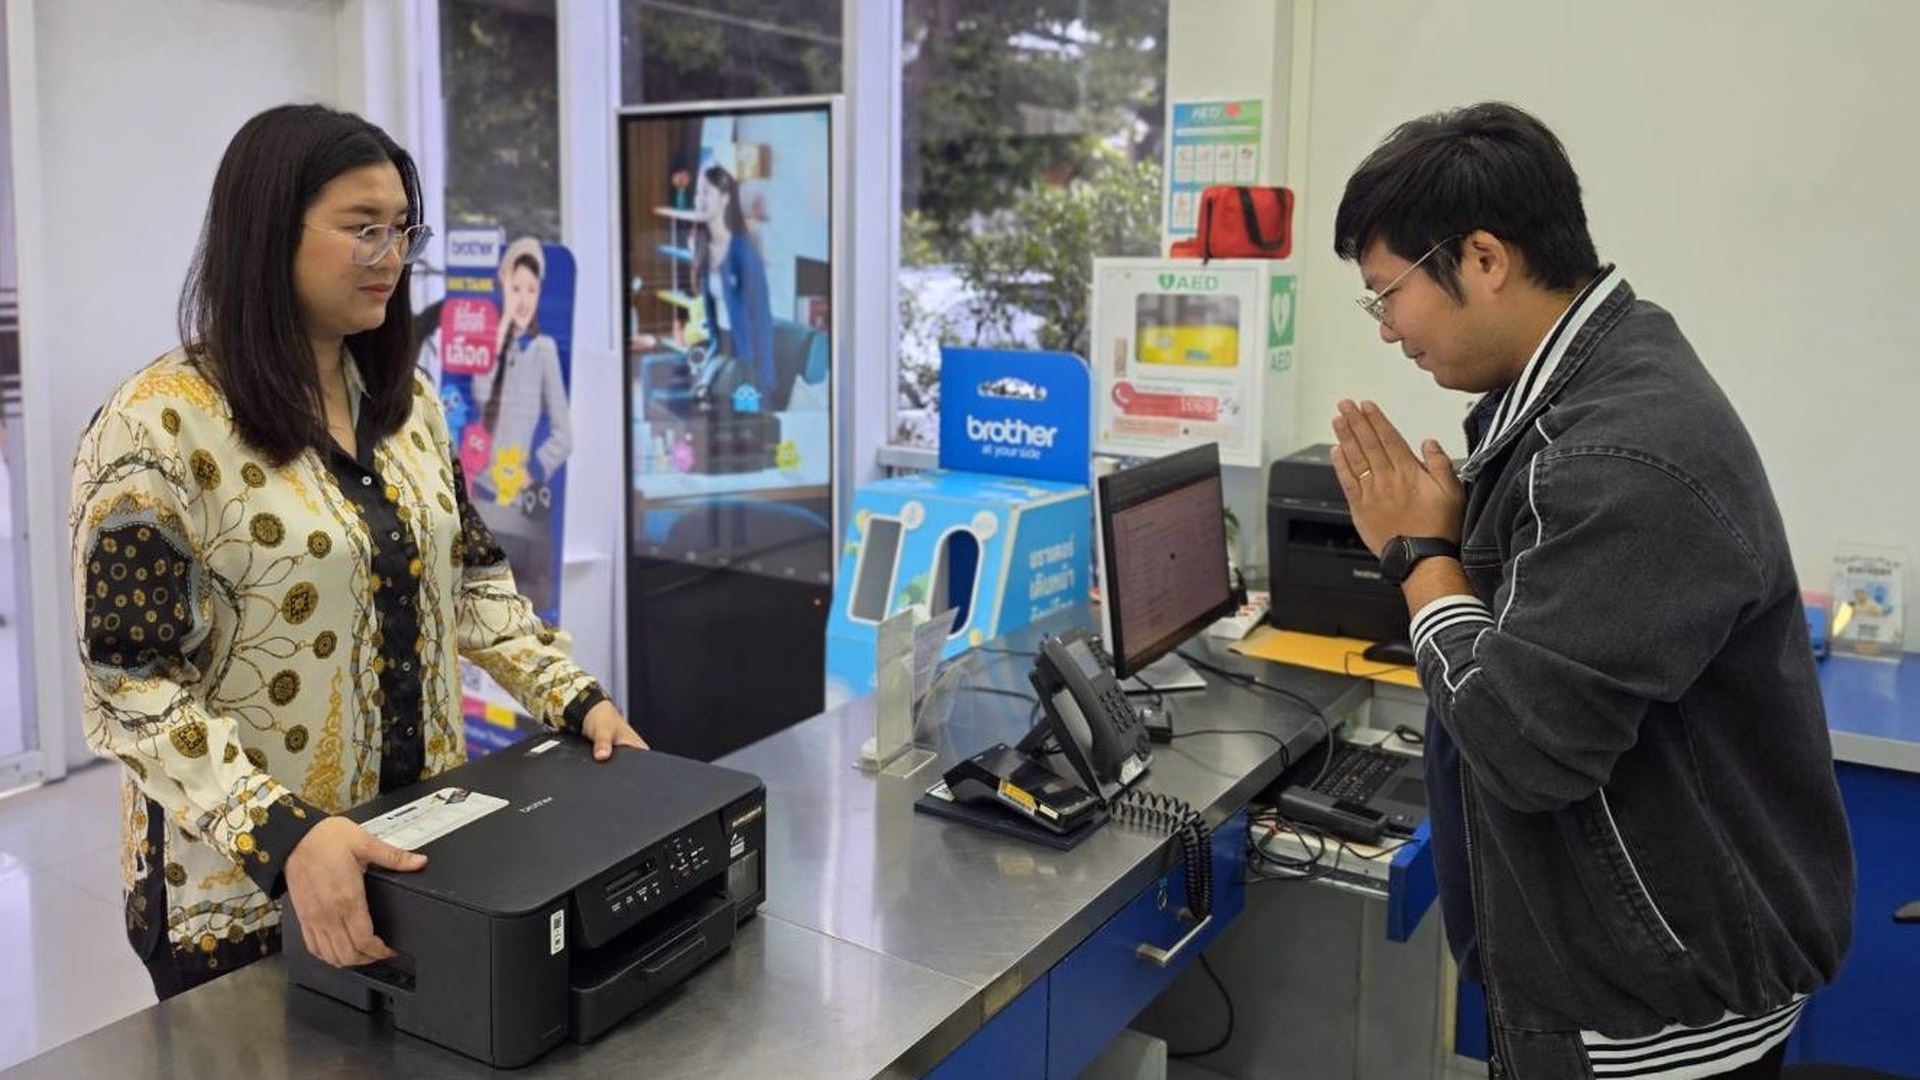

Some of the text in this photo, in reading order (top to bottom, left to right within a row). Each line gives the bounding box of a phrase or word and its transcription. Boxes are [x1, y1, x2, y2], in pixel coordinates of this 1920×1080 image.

[451, 241, 493, 256] brother
[1177, 275, 1218, 291] AED
[445, 336, 490, 368] เลือก
[1270, 350, 1292, 372] AED
[966, 414, 1058, 448] brother
[982, 444, 1041, 460] at your side
